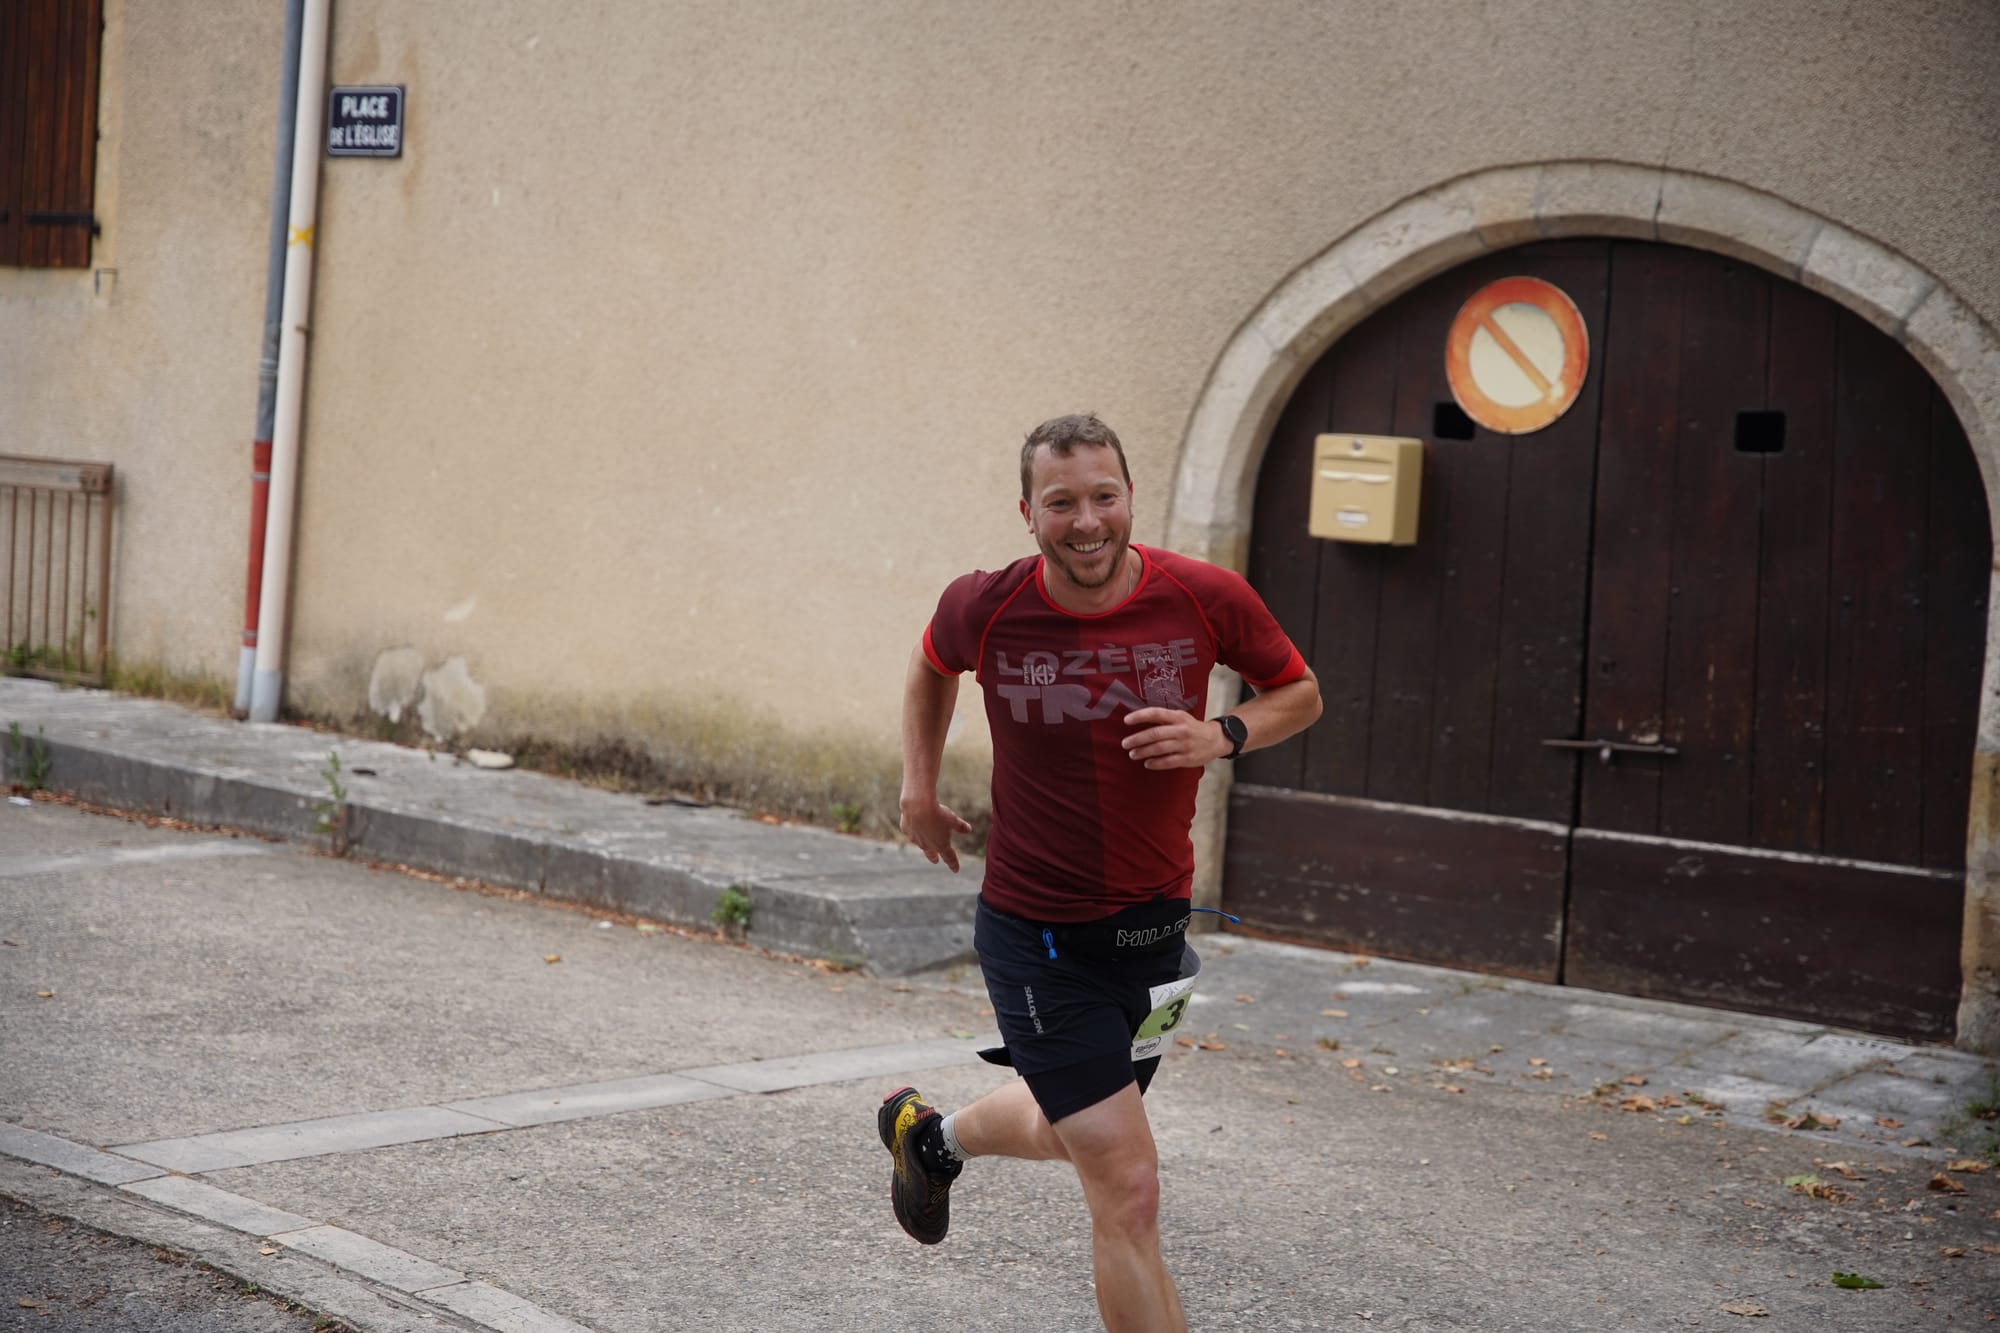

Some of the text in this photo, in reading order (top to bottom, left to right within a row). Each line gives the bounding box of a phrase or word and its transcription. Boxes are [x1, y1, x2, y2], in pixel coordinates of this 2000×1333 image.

[341, 95, 389, 119] PLACE
[329, 120, 398, 147] DE L'ÉGLISE
[996, 638, 1198, 676] LOZÈRE
[1160, 998, 1184, 1031] 3
